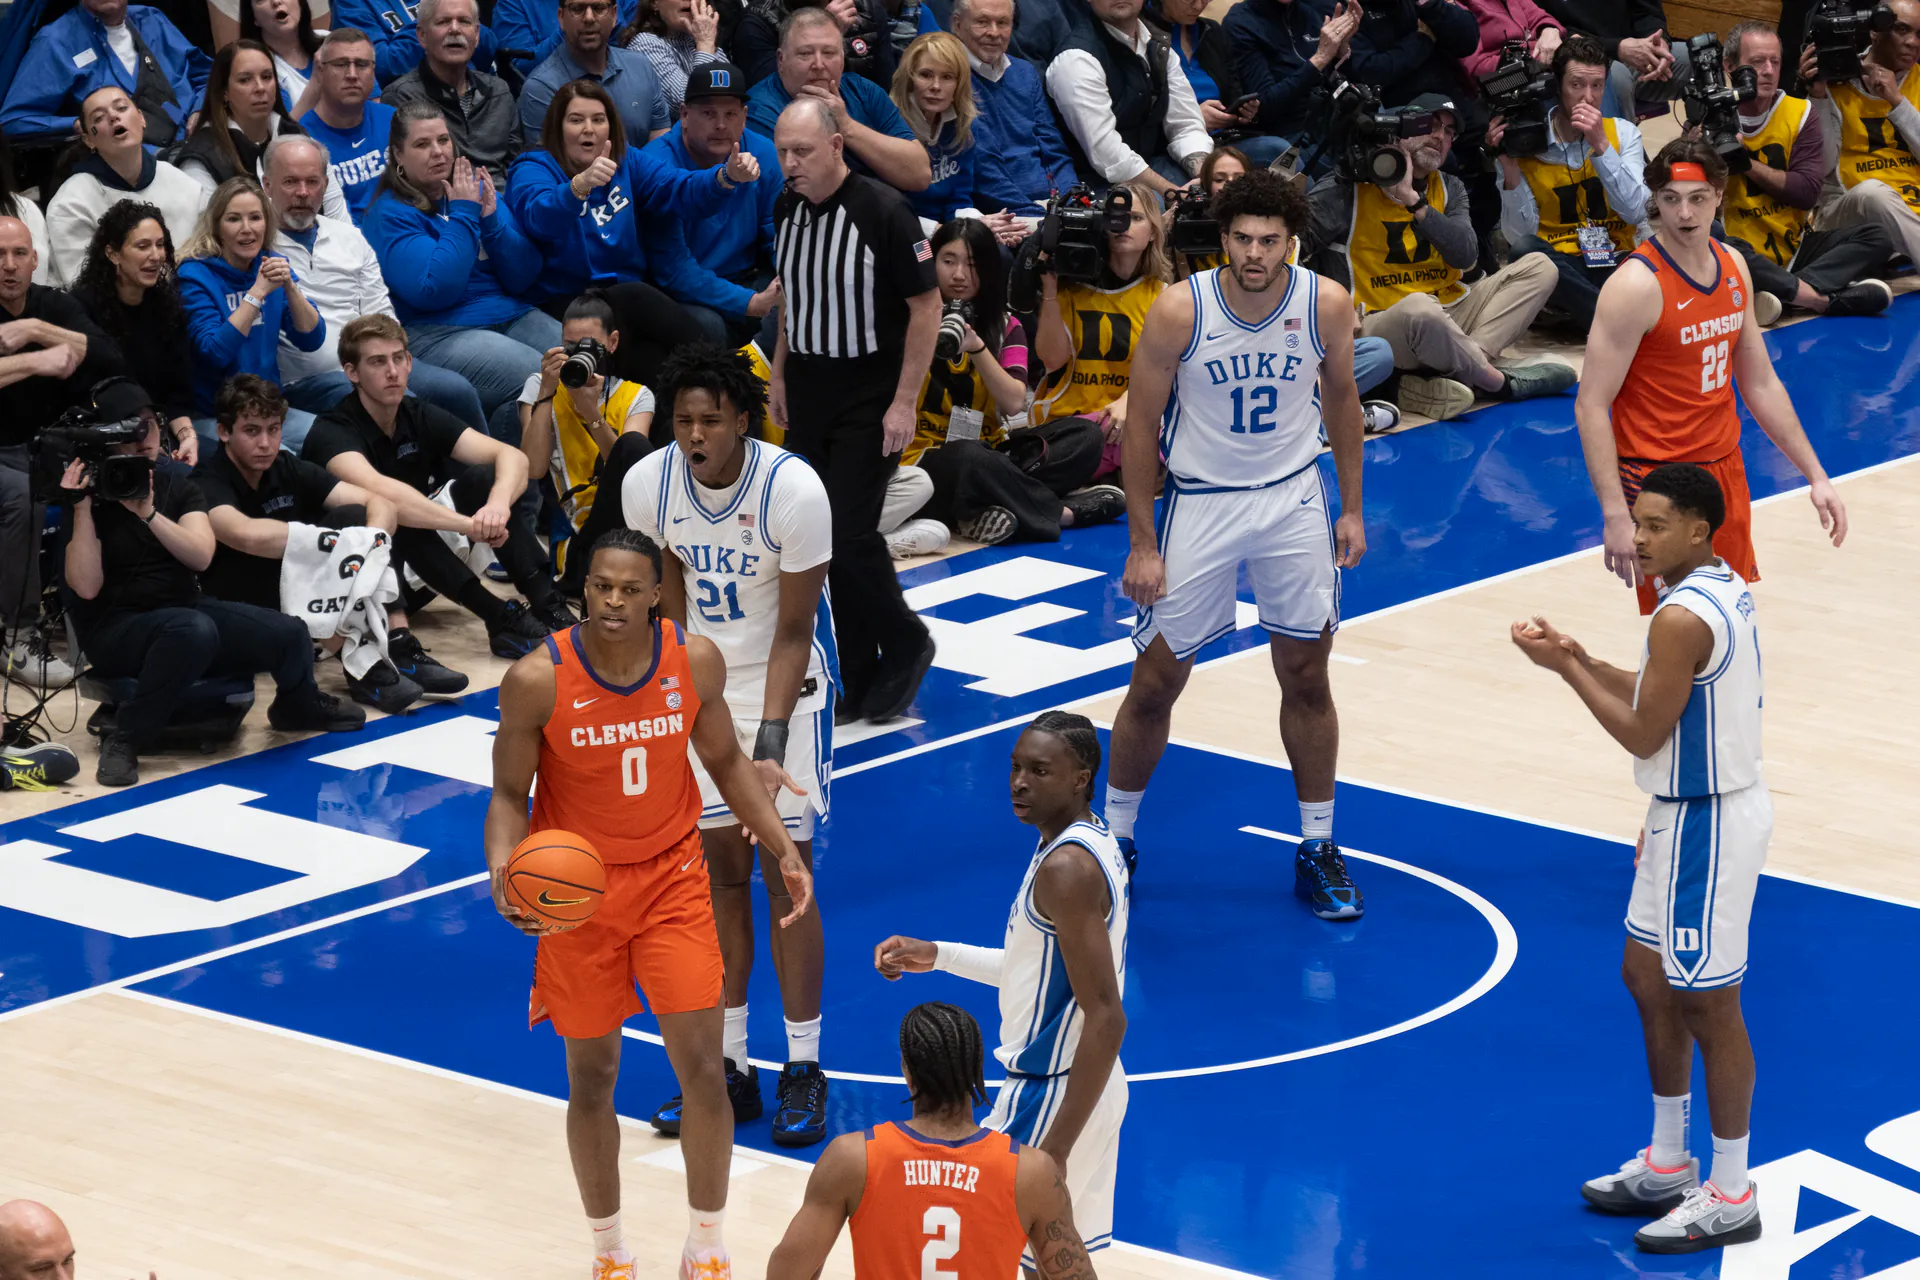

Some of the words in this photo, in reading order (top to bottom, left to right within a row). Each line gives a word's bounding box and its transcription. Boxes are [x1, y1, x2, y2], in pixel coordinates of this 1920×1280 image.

[710, 70, 730, 87] D
[931, 155, 960, 184] uke
[1076, 310, 1132, 362] D
[1680, 311, 1744, 345] CLEMSON
[1204, 352, 1303, 385] DUKE
[1701, 340, 1729, 394] 22
[1230, 385, 1278, 434] 12
[675, 545, 760, 577] DUKE
[696, 578, 746, 623] 21
[571, 713, 684, 747] CLEMSON
[621, 746, 648, 796] 0
[1675, 927, 1700, 951] D
[903, 1160, 980, 1193] HUNTER
[921, 1206, 962, 1280] 2
